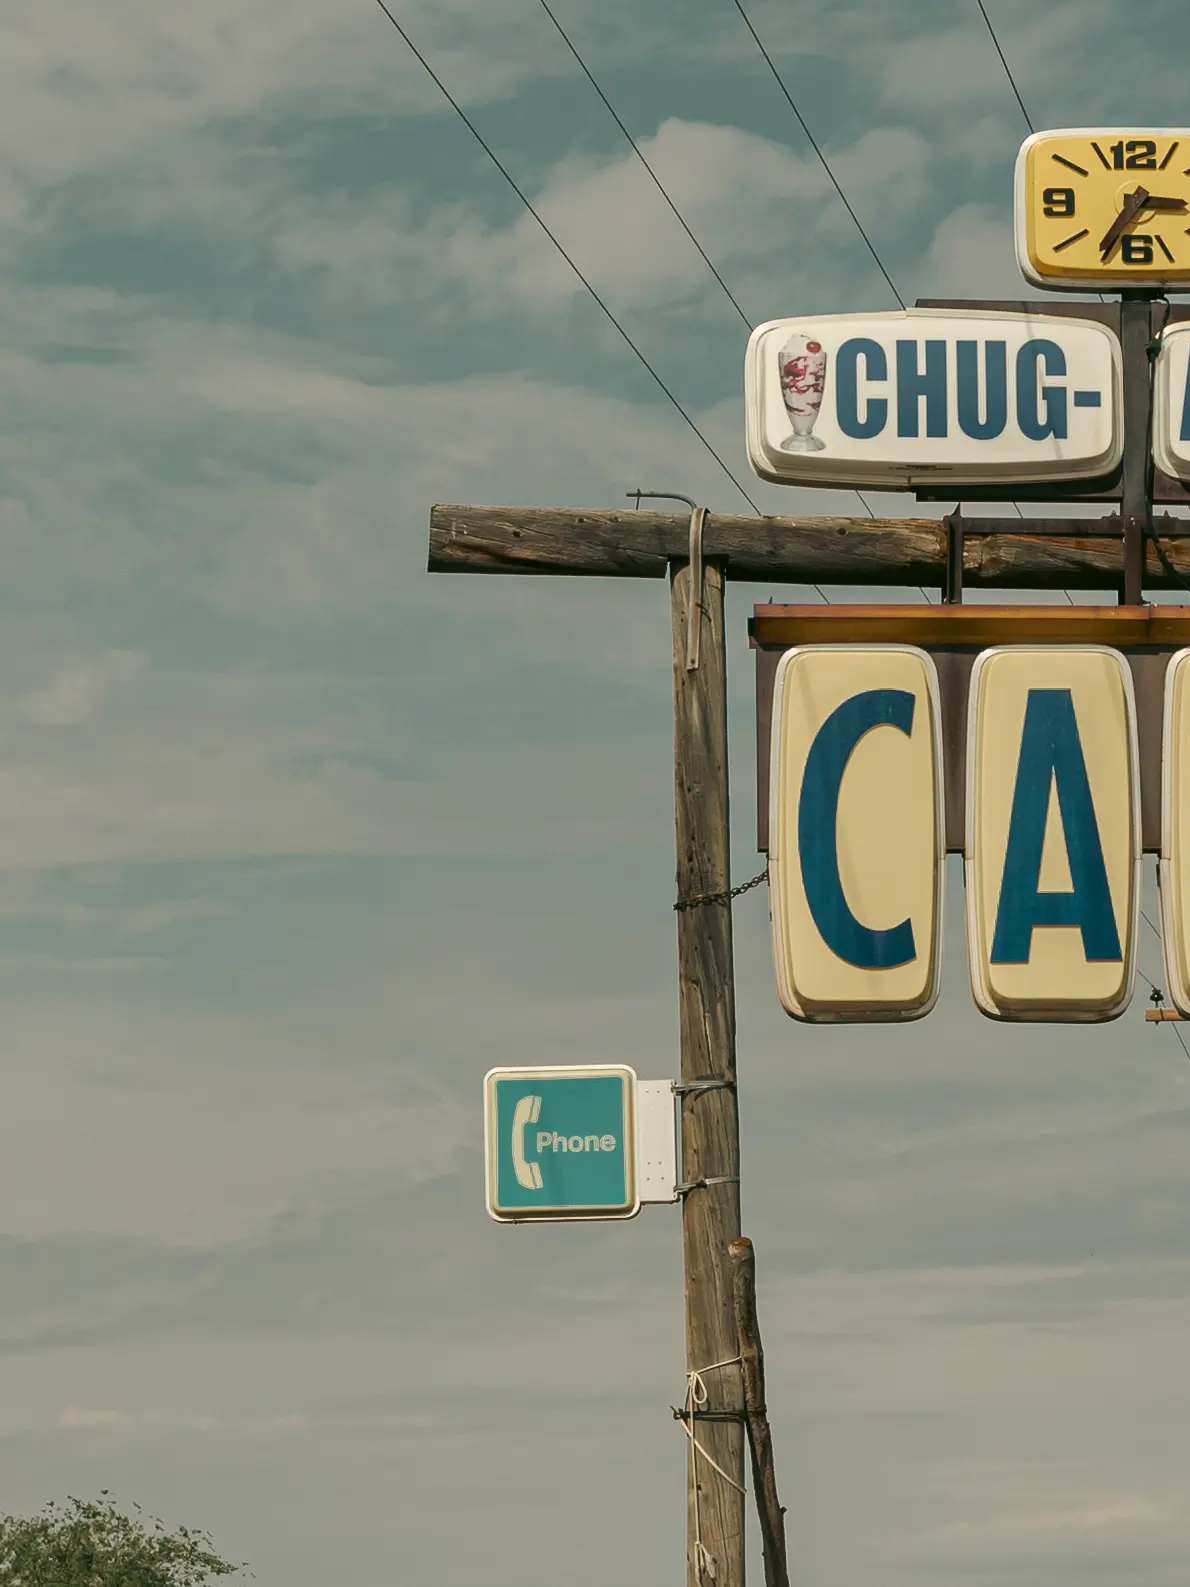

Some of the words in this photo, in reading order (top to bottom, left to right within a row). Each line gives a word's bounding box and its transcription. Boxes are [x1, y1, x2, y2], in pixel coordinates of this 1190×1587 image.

[1110, 140, 1157, 170] 12
[1043, 188, 1075, 216] 9
[1121, 234, 1153, 263] 6
[835, 337, 1102, 441] CHUG-
[536, 1131, 617, 1153] Phone
